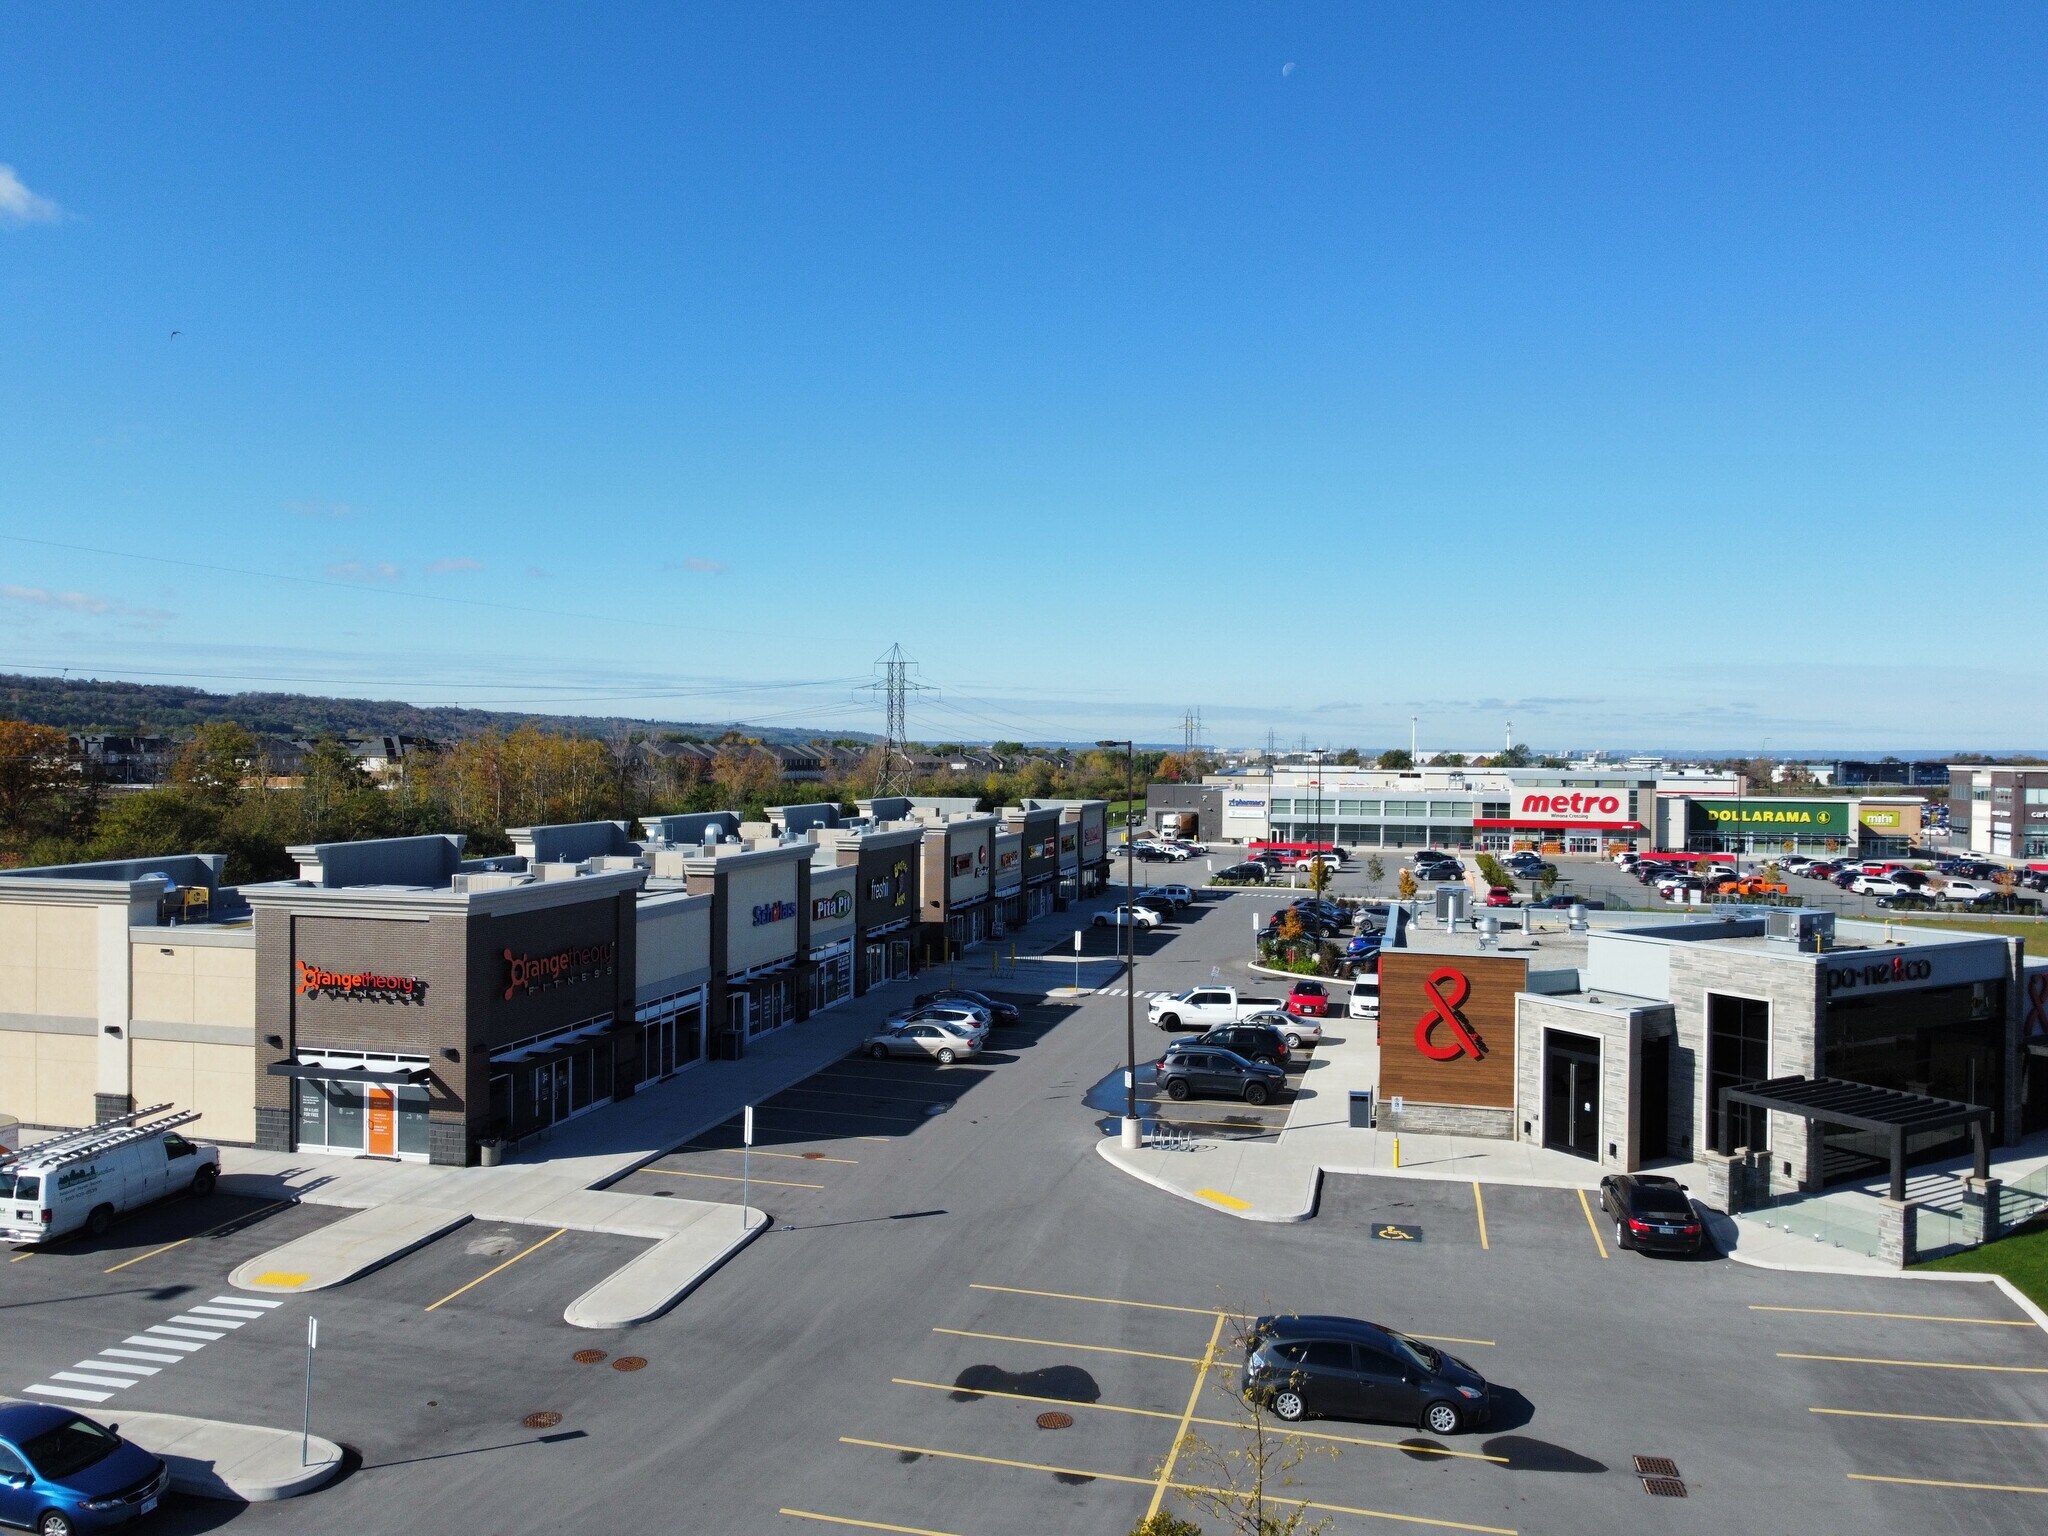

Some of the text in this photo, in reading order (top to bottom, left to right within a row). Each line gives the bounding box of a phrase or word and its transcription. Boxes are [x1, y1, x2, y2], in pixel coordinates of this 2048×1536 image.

[1522, 792, 1620, 814] metro
[1708, 811, 1811, 823] DOLLARAMA
[1867, 813, 1893, 823] mihi
[817, 896, 851, 919] Pita Pit
[528, 966, 613, 996] FITNESS
[319, 988, 413, 1000] FITNESS
